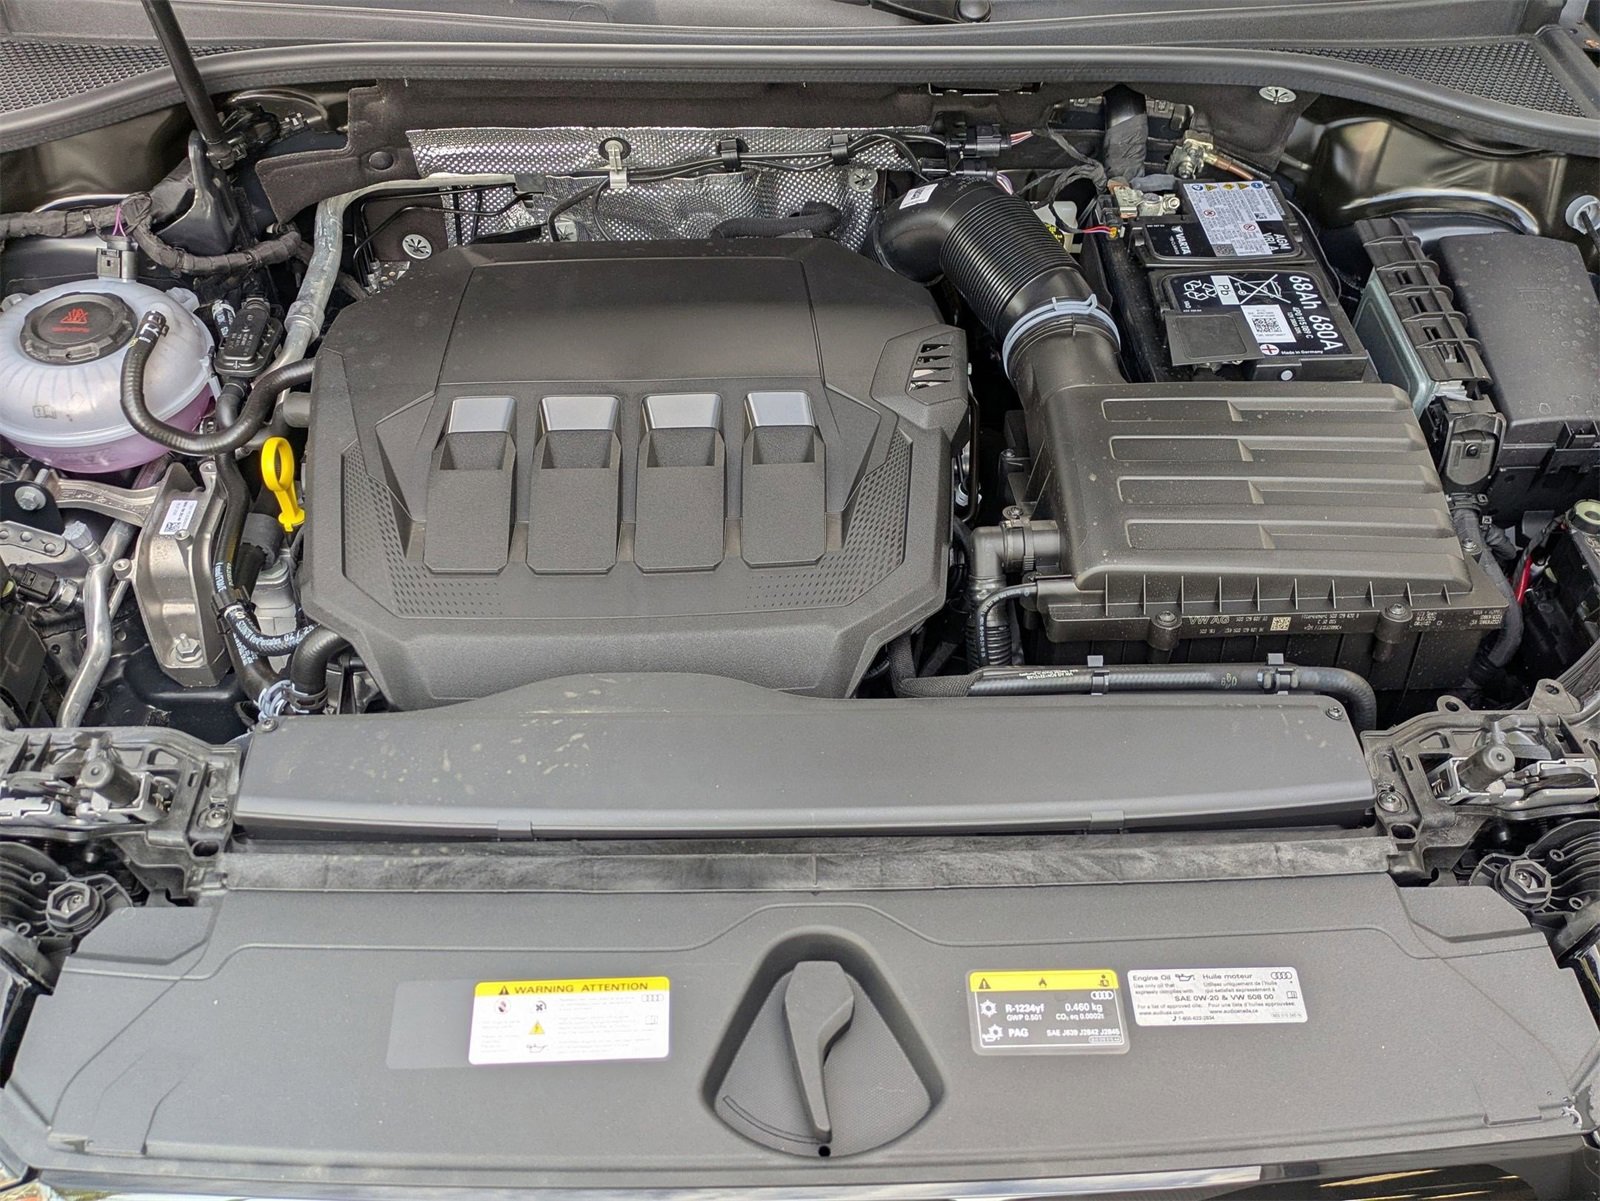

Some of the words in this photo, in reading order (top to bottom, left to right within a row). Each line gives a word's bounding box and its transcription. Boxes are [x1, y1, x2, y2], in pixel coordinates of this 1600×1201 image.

[1175, 233, 1192, 255] VARTA
[1273, 233, 1292, 250] AGM
[1217, 284, 1231, 296] Pb
[1289, 275, 1323, 310] 68Ah
[1309, 315, 1344, 351] 680A
[514, 985, 574, 994] WARNING
[581, 982, 648, 992] ATTENTION
[1193, 993, 1220, 1001] 0W-20
[1005, 1003, 1045, 1014] R-1234yf
[1064, 1002, 1090, 1012] 0.460
[1091, 1002, 1104, 1013] kg
[1008, 1027, 1029, 1038] PAG
[1046, 1029, 1061, 1037] SAE
